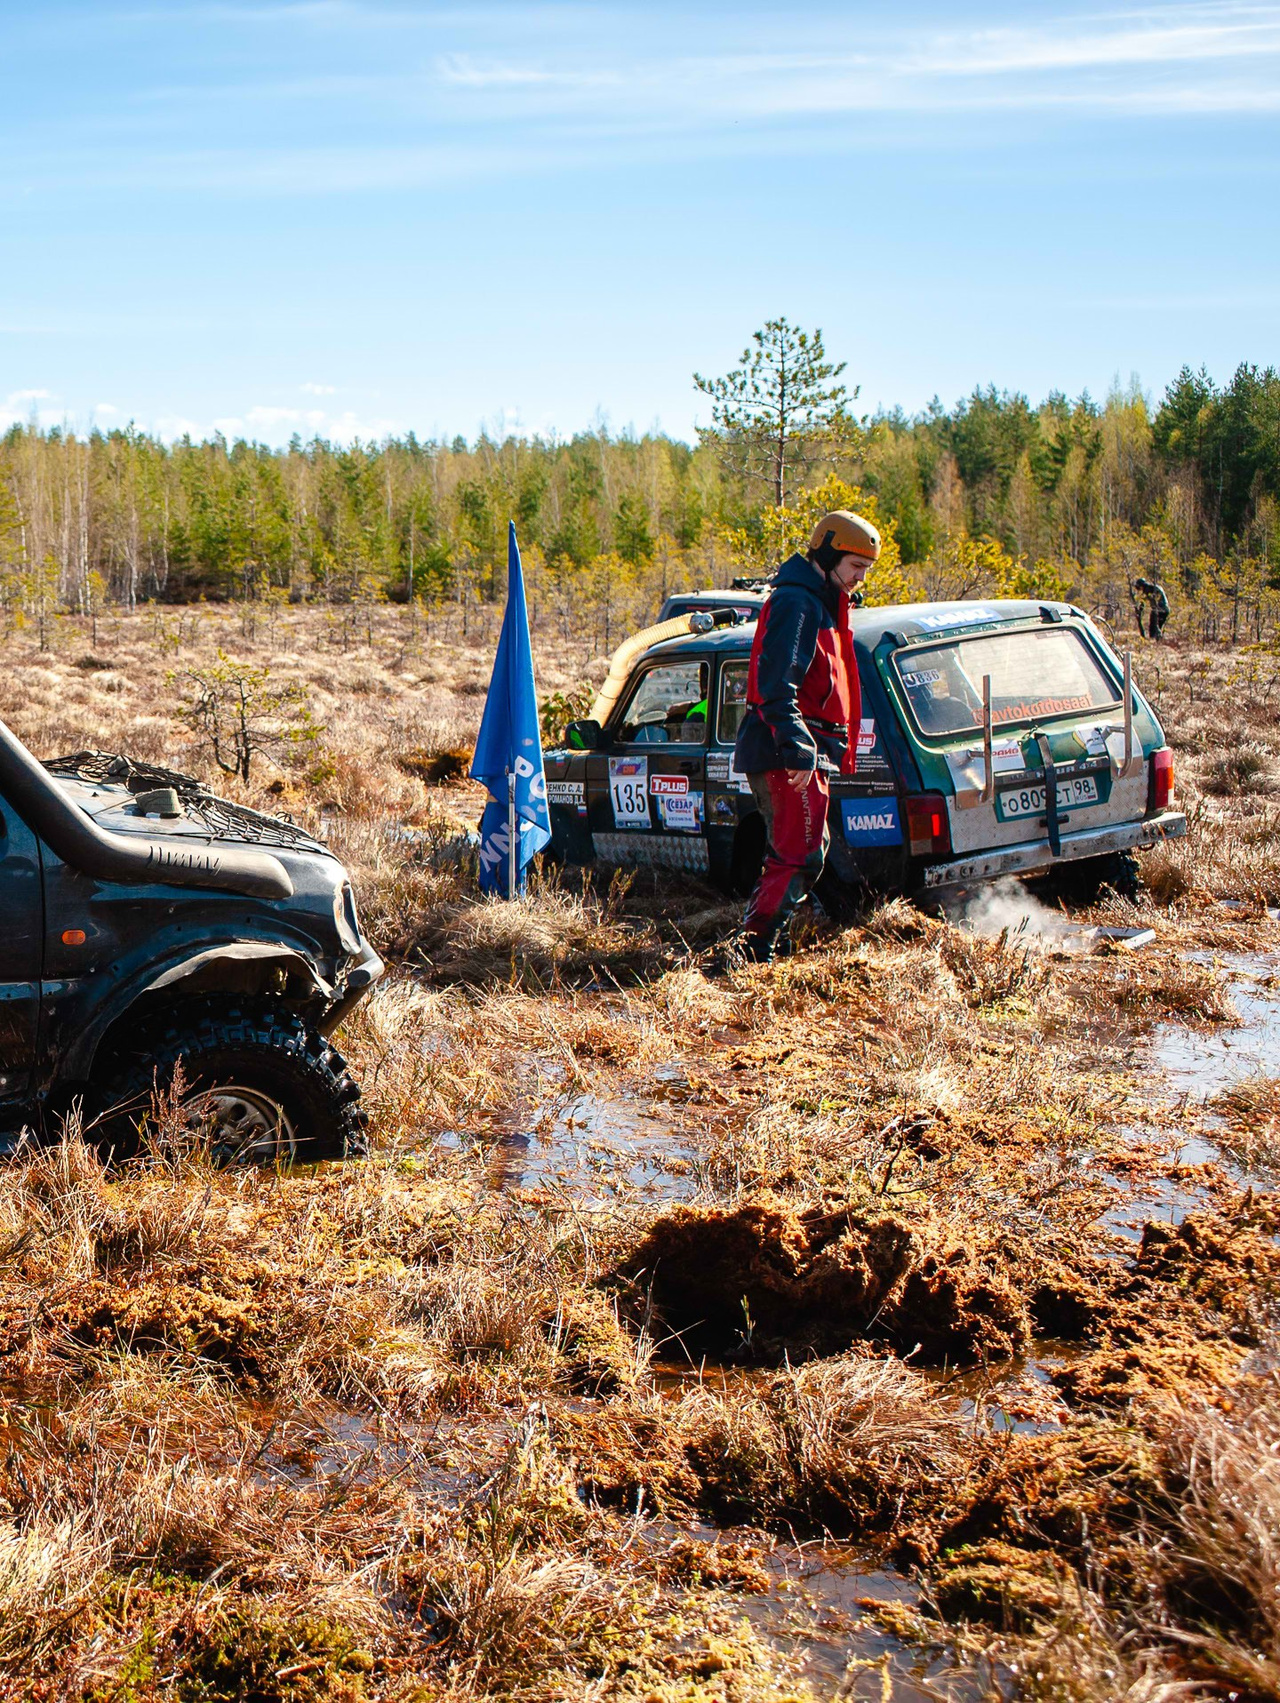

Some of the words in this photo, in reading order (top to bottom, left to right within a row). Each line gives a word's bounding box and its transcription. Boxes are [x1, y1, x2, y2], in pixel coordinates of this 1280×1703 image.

[789, 612, 806, 668] FINNTRAIL
[653, 779, 686, 792] TPLUS
[1074, 780, 1091, 795] 98
[613, 784, 646, 813] 135
[846, 813, 895, 831] KAMAZ
